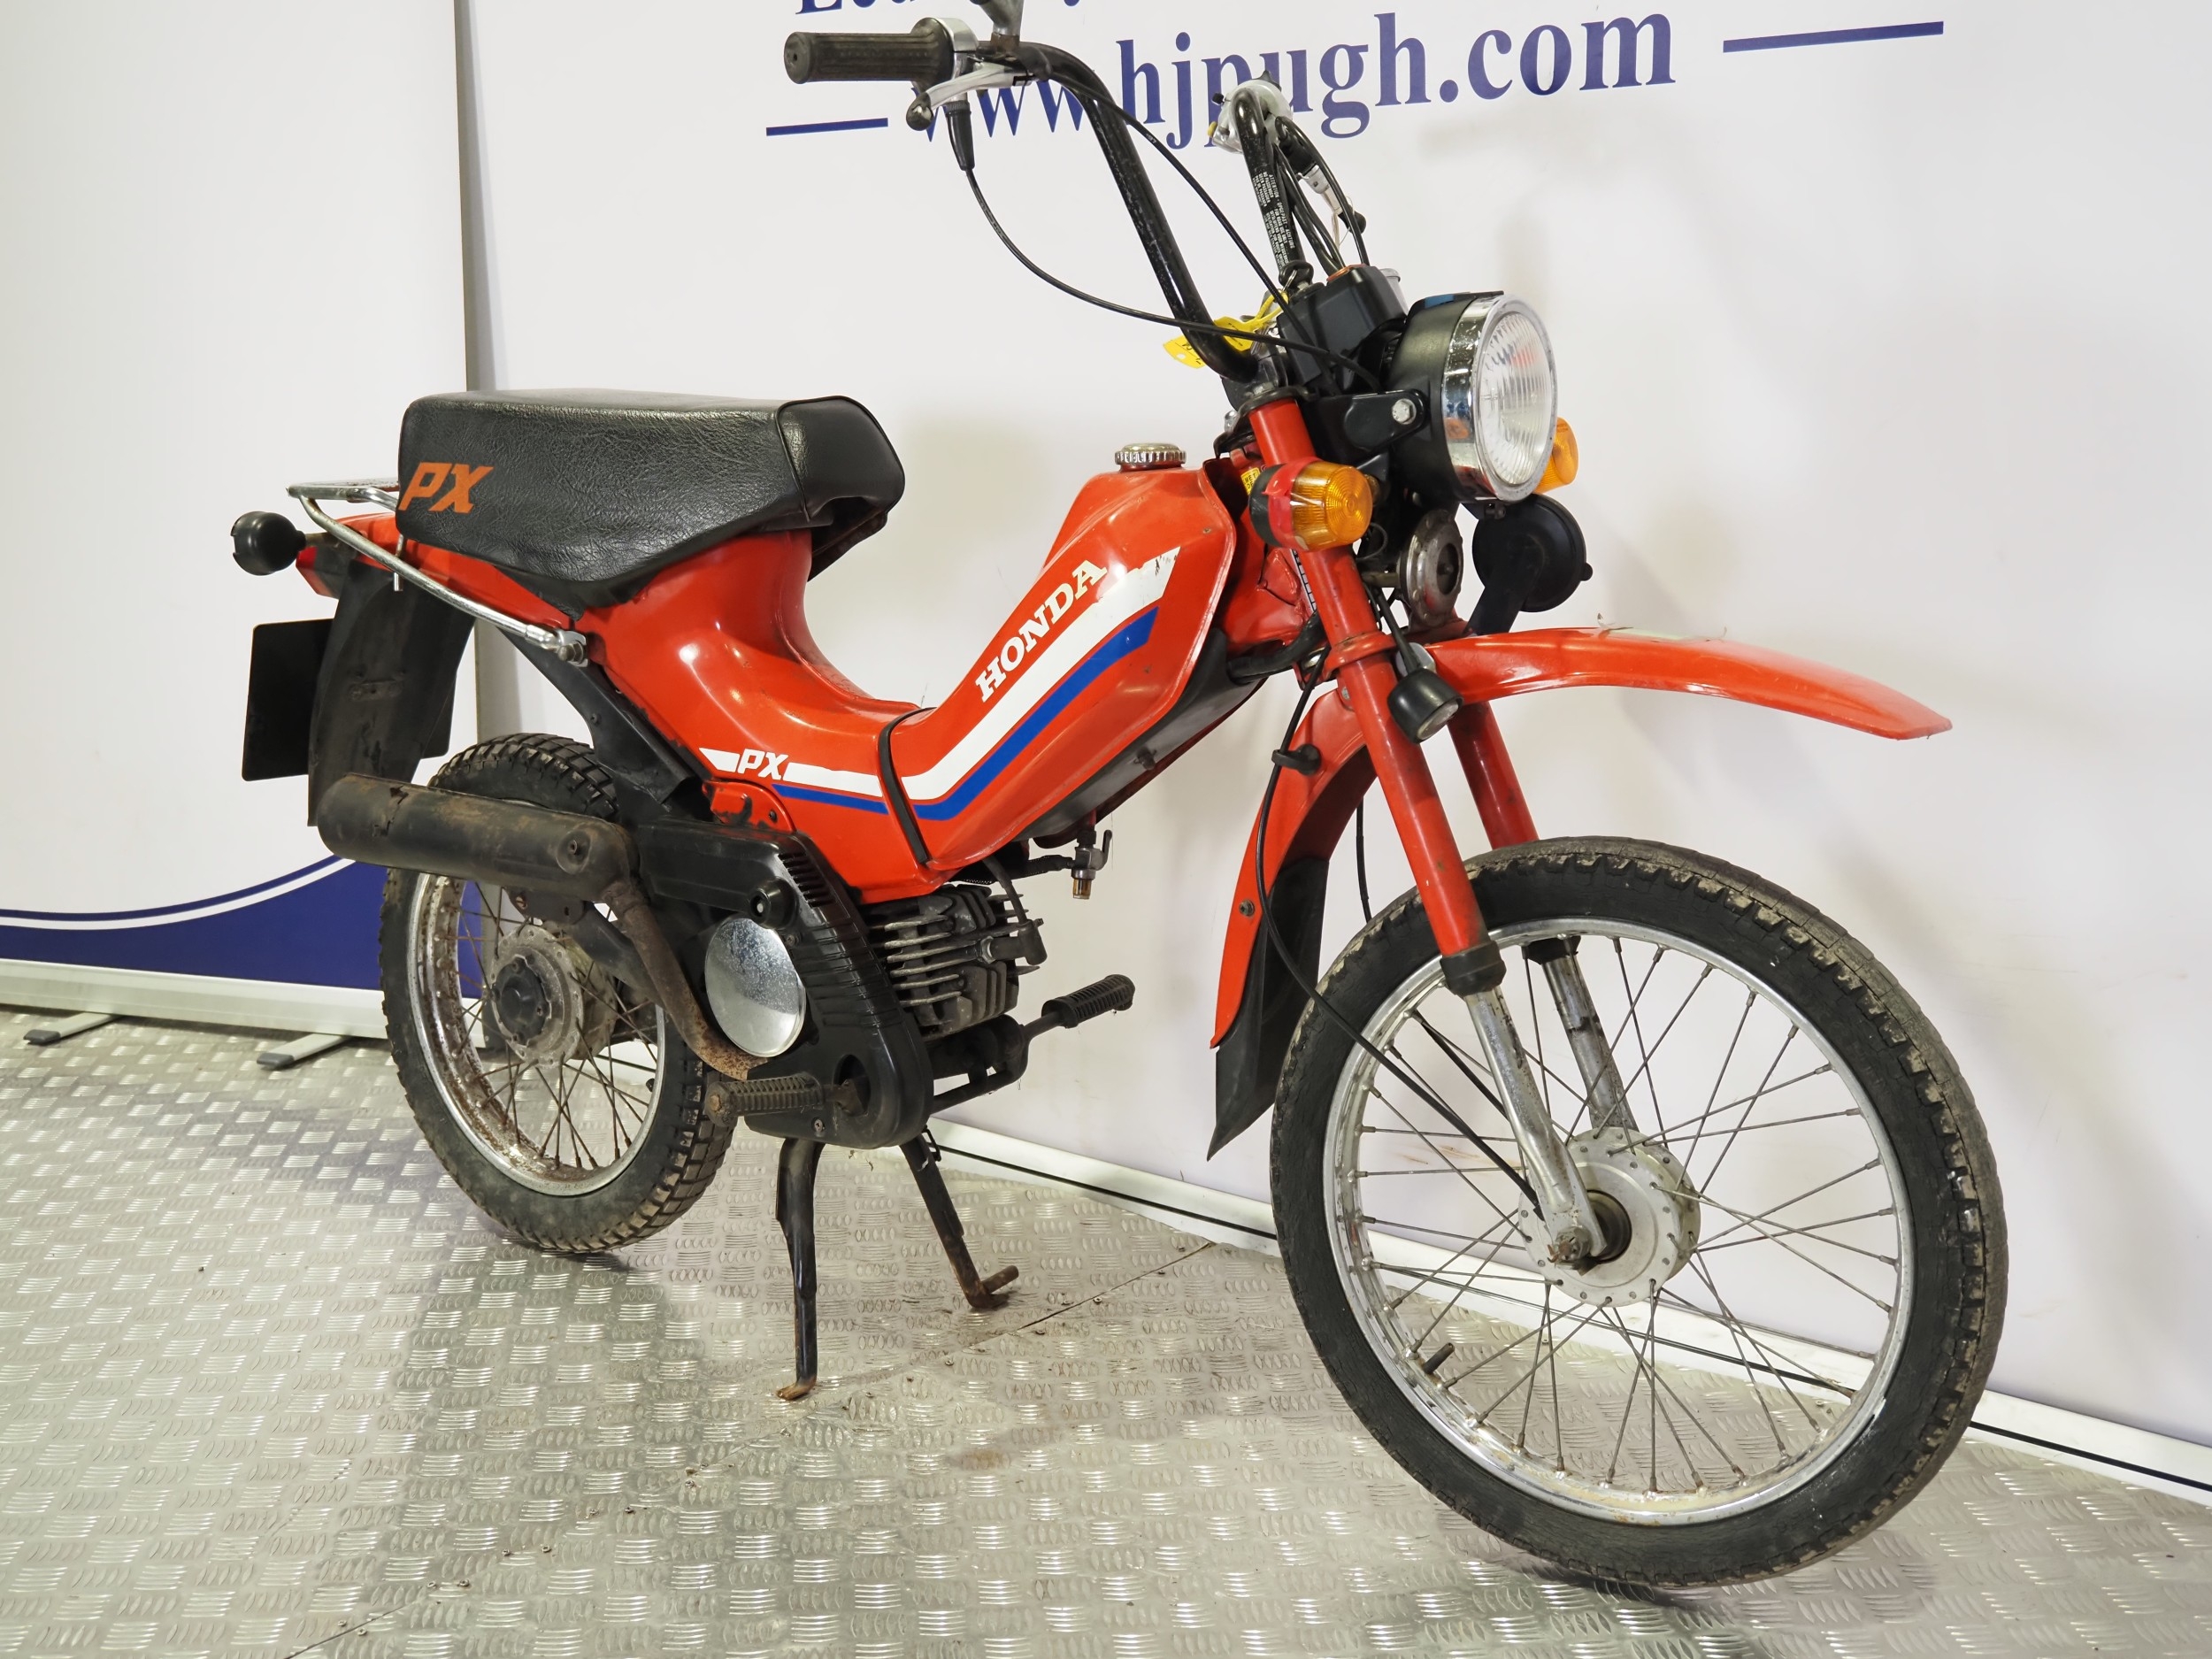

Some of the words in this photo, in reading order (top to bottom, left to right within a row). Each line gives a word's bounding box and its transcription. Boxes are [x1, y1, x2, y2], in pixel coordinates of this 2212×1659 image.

[398, 461, 494, 513] PX
[976, 558, 1108, 702] HONDA
[737, 749, 789, 781] PX
